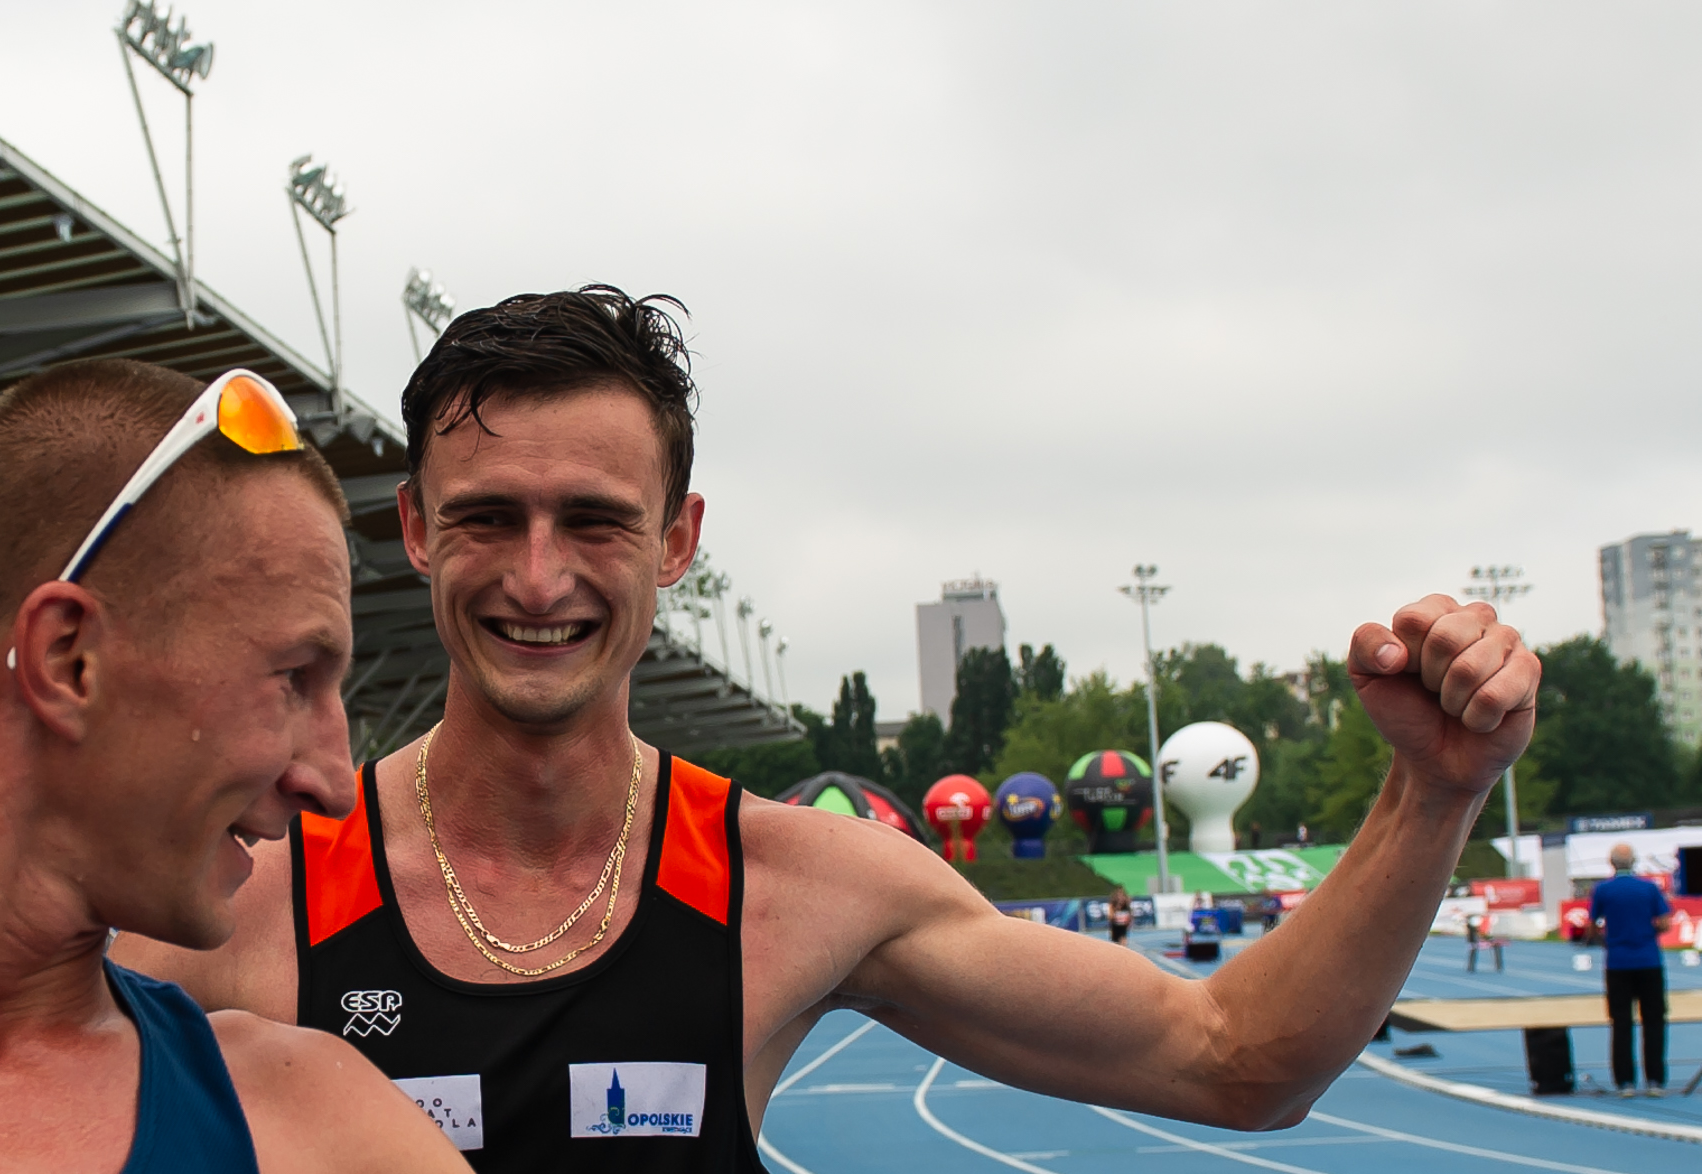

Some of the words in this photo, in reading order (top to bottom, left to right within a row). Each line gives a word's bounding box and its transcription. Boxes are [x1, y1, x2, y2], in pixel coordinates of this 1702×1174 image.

[1161, 760, 1180, 784] F
[1208, 756, 1248, 781] 4F
[627, 1113, 694, 1127] OPOLSKIE
